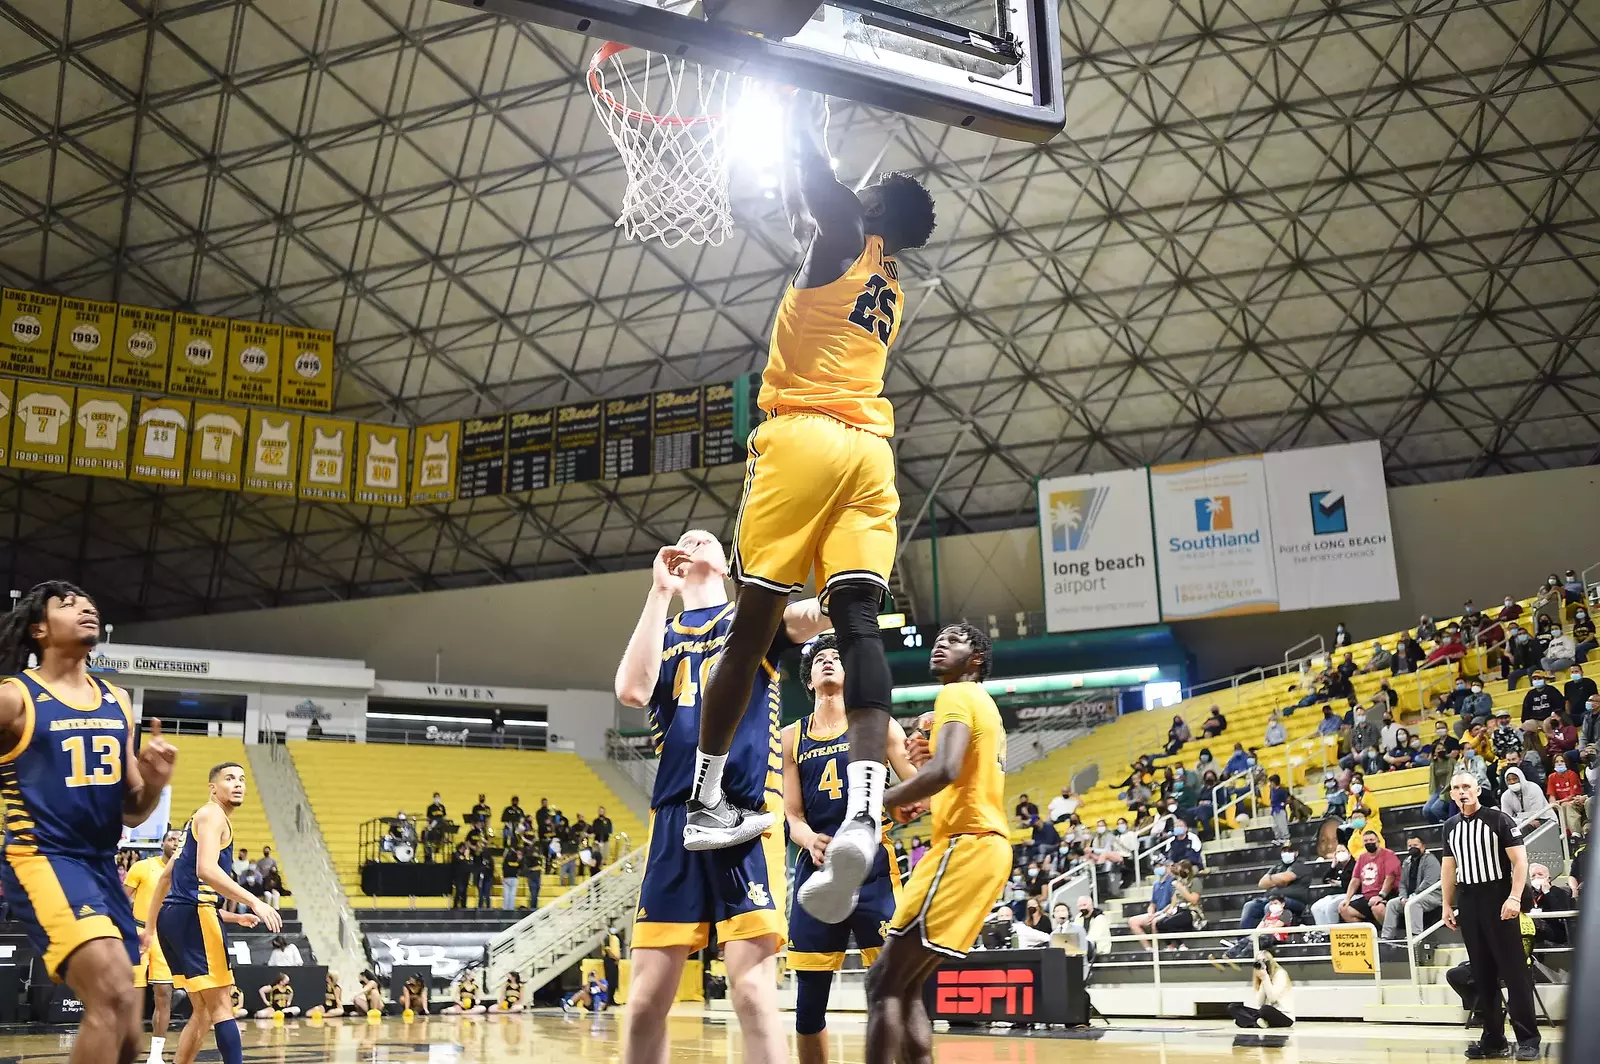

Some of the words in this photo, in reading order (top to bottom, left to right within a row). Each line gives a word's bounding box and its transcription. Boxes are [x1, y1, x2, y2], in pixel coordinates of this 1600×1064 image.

[5, 290, 26, 301] LONG
[31, 294, 57, 306] BEACH
[17, 304, 41, 315] STATE
[64, 300, 85, 311] LONG
[88, 303, 115, 314] BEACH
[848, 273, 897, 347] 25
[75, 312, 100, 323] STATE
[121, 308, 141, 319] LONG
[144, 311, 171, 323] BEACH
[178, 315, 197, 326] LONG
[201, 318, 226, 329] BEACH
[13, 322, 41, 336] 1989
[132, 320, 157, 331] STATE
[190, 327, 212, 338] STATE
[232, 322, 251, 333] LONG
[255, 325, 280, 337] BEACH
[72, 332, 99, 345] 1993
[244, 335, 267, 345] STATE
[285, 330, 304, 340] LONG
[308, 332, 332, 343] BEACH
[297, 342, 320, 352] STATE
[10, 353, 34, 363] NCAA
[0, 361, 46, 376] HAMPIONS
[70, 361, 93, 372] NCAA
[127, 367, 150, 378] NCAA
[54, 369, 105, 383] CHAMPIONS
[113, 376, 162, 389] CHAMPIONS
[185, 376, 207, 386] NCAA
[171, 383, 220, 397] CHAMPIONS
[241, 383, 263, 393] NCAA
[296, 388, 316, 398] NCAA
[38, 417, 49, 433] 7
[96, 422, 107, 438] 2
[261, 448, 283, 465] 42
[1169, 528, 1260, 552] Southland
[1280, 544, 1299, 553] Port
[1301, 543, 1311, 551] of
[1314, 540, 1345, 551] LONG
[1349, 535, 1387, 546] BEACH
[1053, 561, 1090, 576] long
[1095, 554, 1145, 572] beach
[1054, 577, 1106, 595] airport
[903, 634, 922, 647] 41
[134, 656, 209, 673] CONCESSIONS
[427, 686, 495, 699] WOMEN
[61, 735, 122, 788] 13
[818, 758, 843, 800] 4
[936, 969, 1034, 1015] ESPN
[62, 999, 82, 1007] Digni
